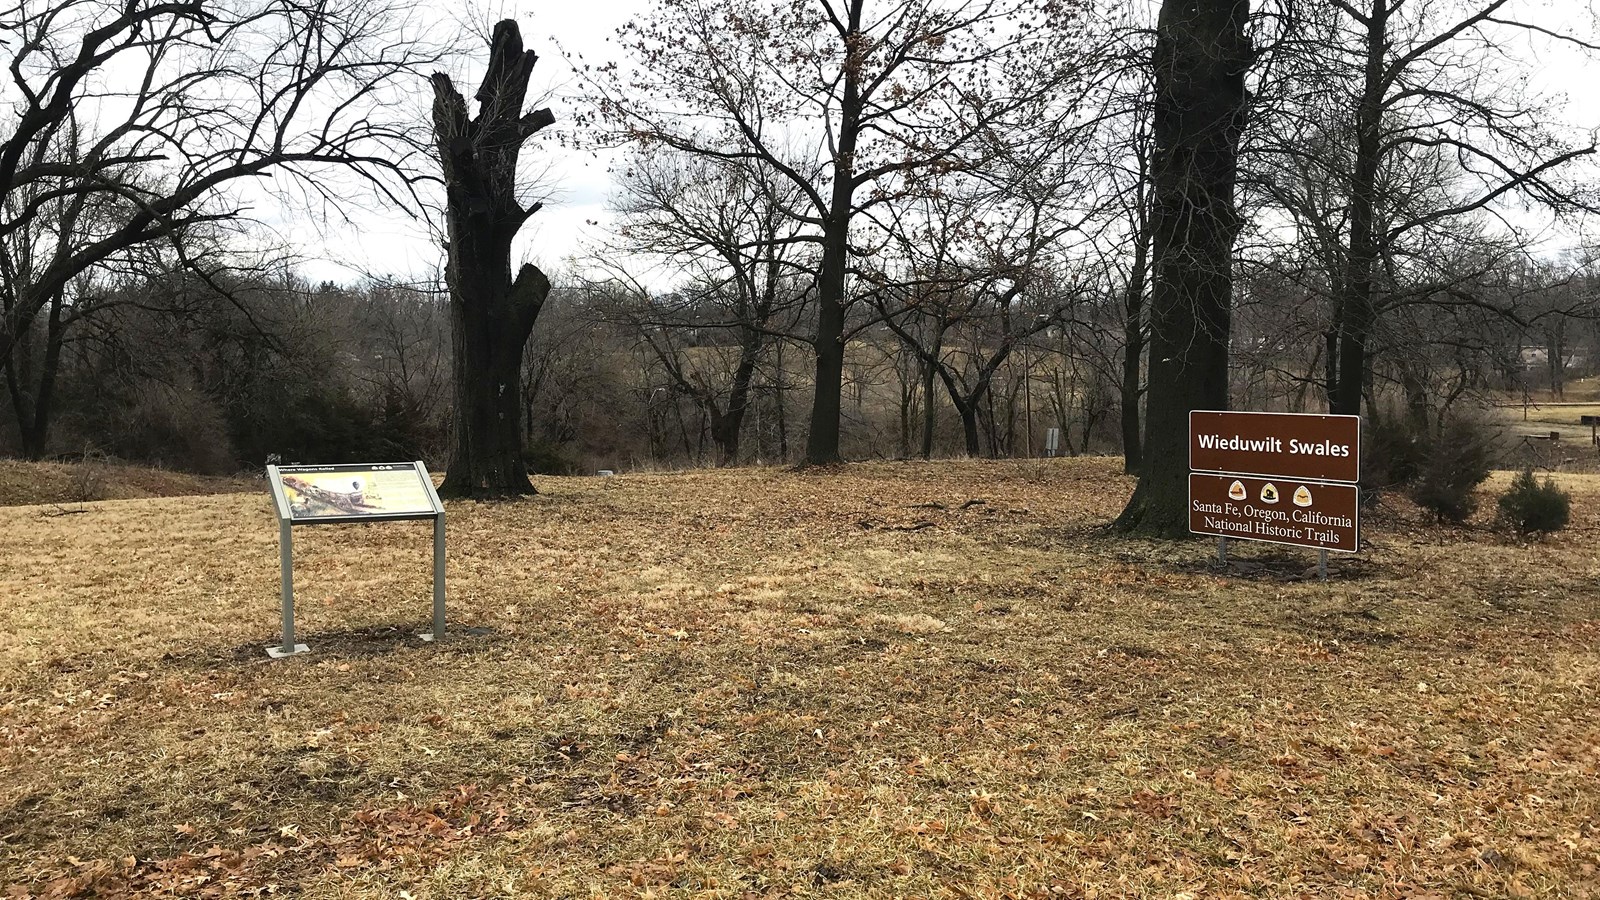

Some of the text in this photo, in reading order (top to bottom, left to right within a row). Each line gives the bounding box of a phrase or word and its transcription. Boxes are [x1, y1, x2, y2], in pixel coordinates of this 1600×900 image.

[1198, 434, 1350, 457] Wieduwilt Swales
[1192, 499, 1353, 528] Santa Fe, Oregon, California
[1204, 516, 1340, 544] National Historic Trails
